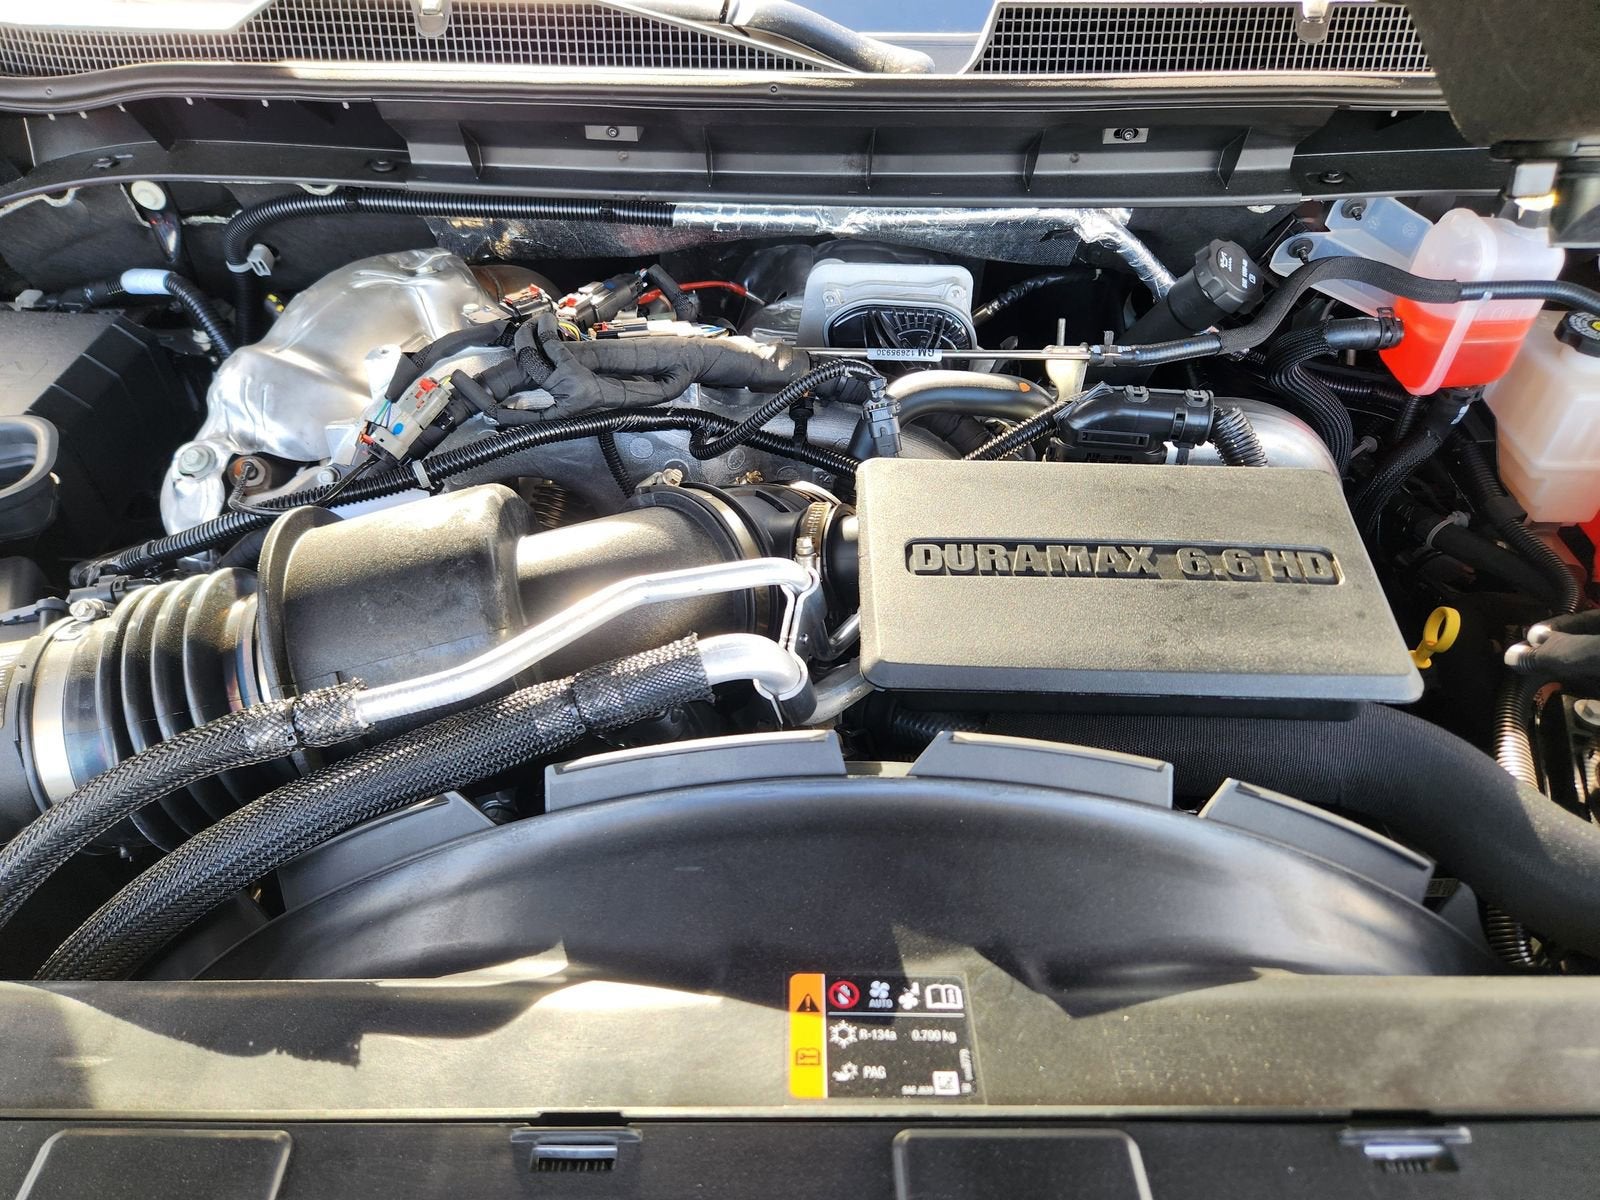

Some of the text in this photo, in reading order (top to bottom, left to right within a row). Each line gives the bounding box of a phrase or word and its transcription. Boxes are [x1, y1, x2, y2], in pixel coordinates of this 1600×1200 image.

[876, 348, 935, 357] GM 12695930
[911, 543, 1337, 581] DURAMAX 6.6 HD
[868, 998, 893, 1009] AUTO
[858, 1028, 957, 1044] R-134a 0.700 kg
[862, 1065, 887, 1079] PAG
